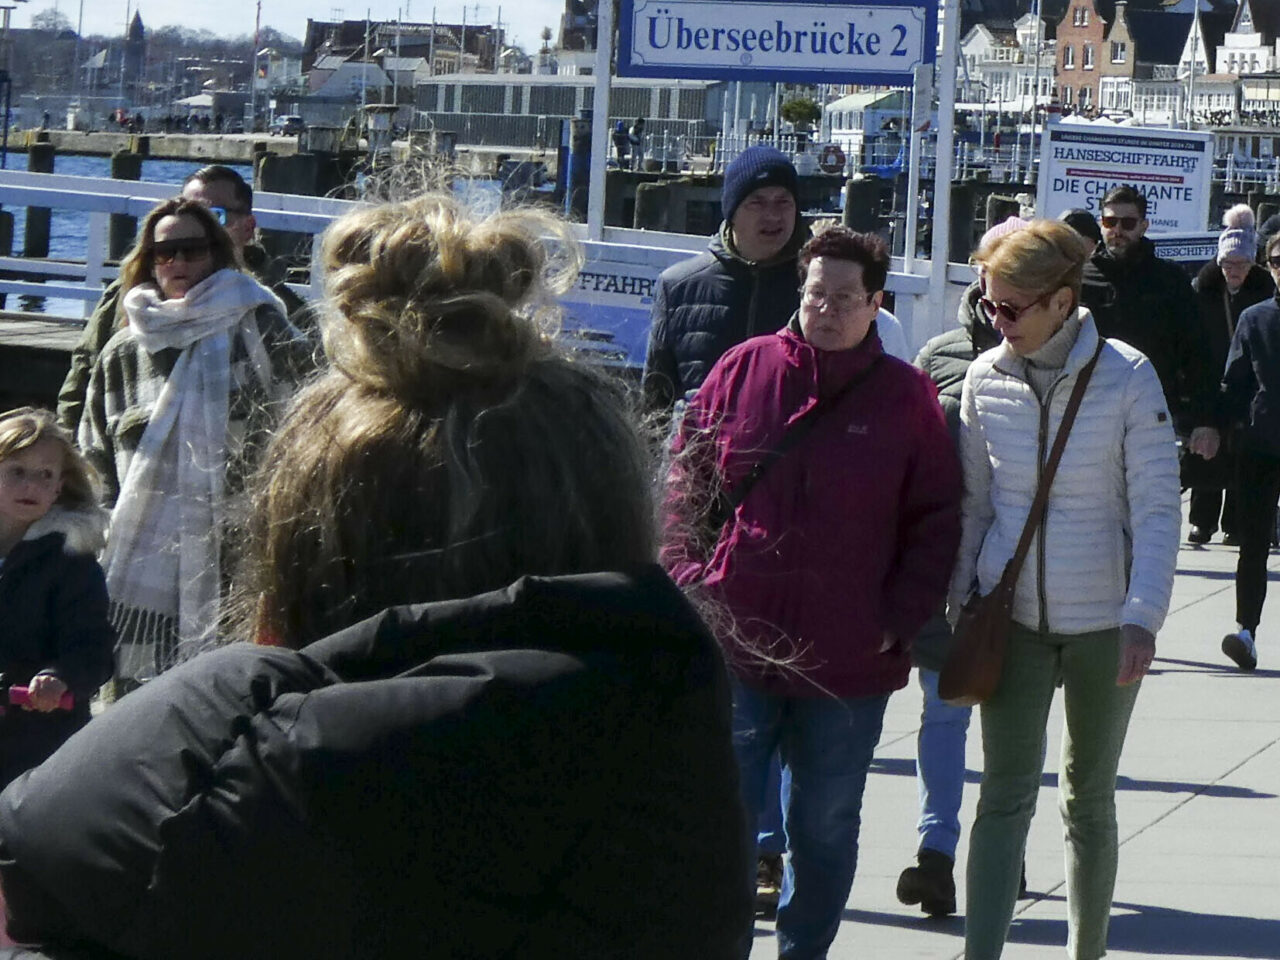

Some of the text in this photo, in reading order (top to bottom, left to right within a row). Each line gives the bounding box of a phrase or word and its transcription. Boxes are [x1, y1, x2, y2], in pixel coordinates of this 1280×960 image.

[648, 8, 908, 57] Überseebrücke 2
[1053, 147, 1199, 169] HANSESCHIFFFAHRT
[1053, 178, 1079, 194] DIE
